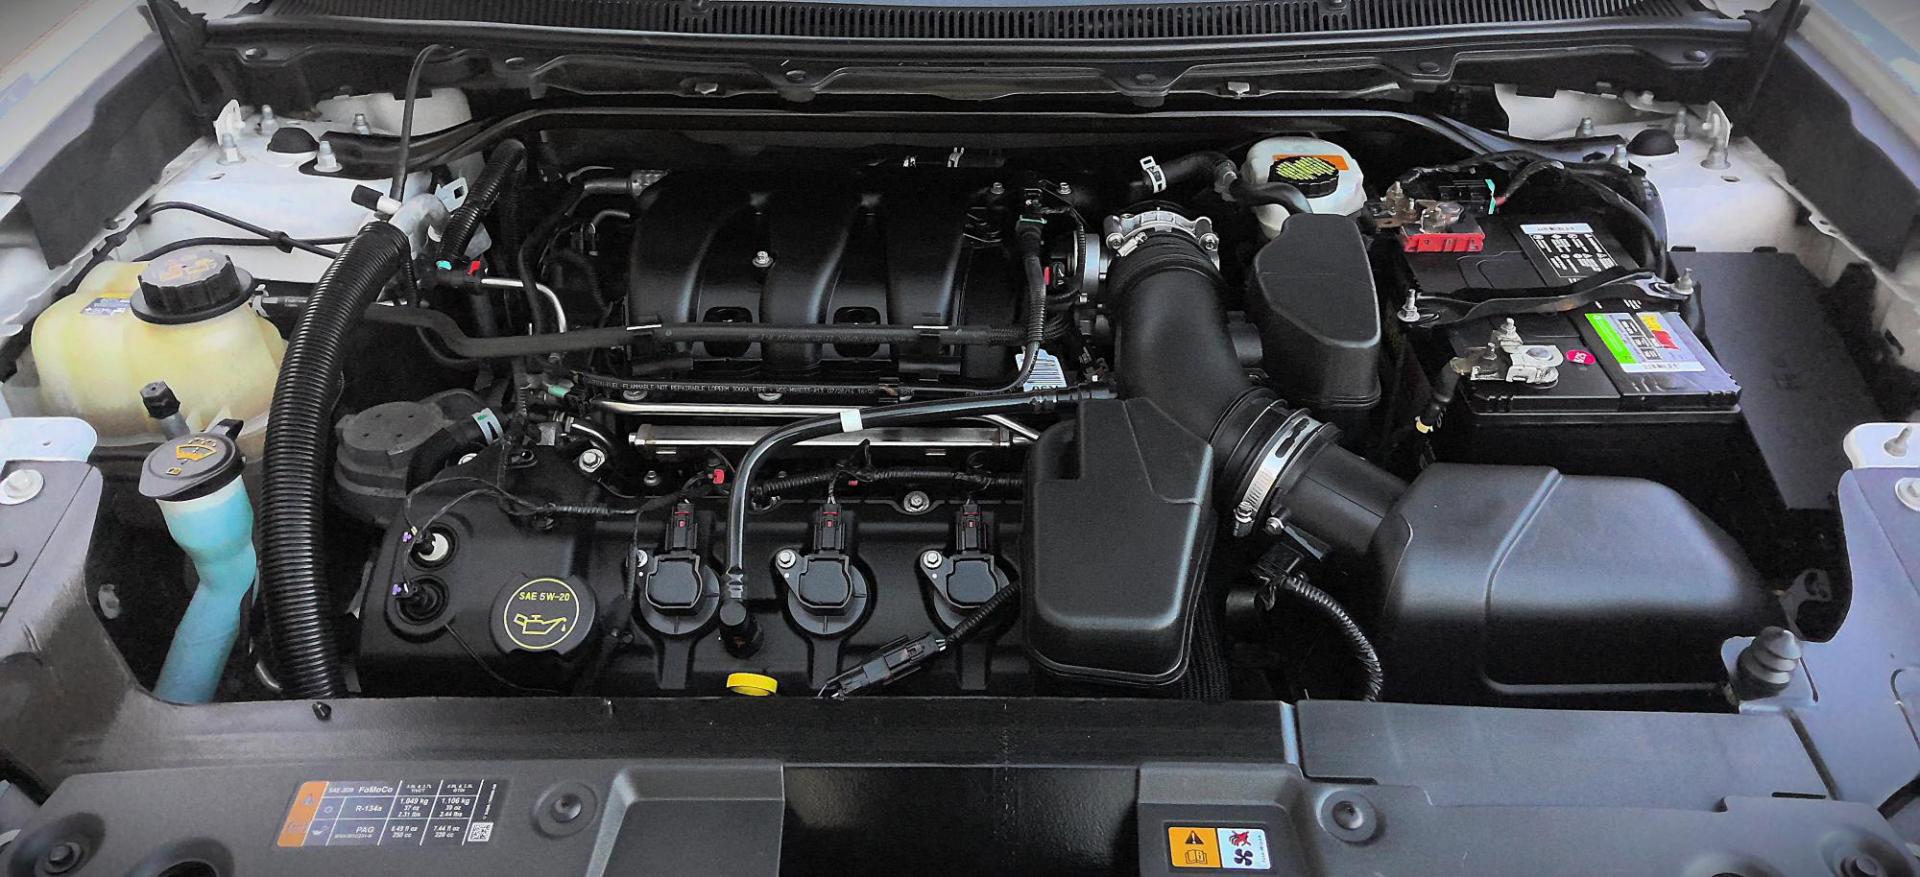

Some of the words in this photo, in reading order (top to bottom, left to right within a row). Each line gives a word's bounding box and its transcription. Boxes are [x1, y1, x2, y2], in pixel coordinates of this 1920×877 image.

[519, 591, 538, 601] SAE
[540, 592, 570, 601] 5W-20
[419, 797, 429, 806] kg
[460, 797, 471, 806] kg
[355, 804, 383, 812] R-134a
[355, 826, 375, 834] PAG
